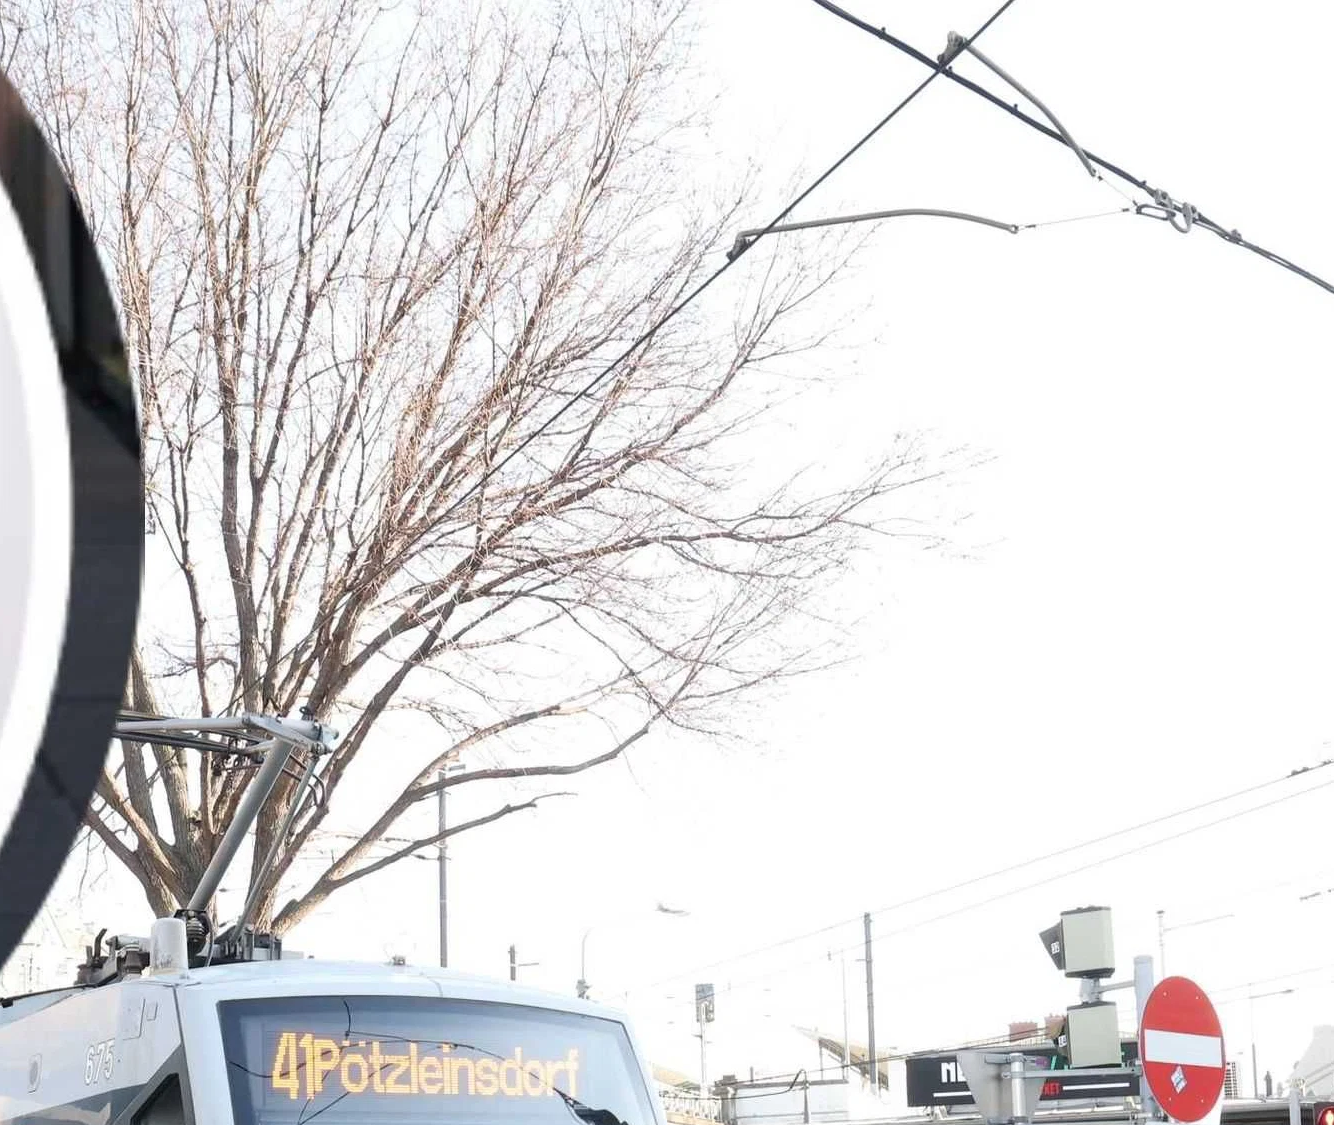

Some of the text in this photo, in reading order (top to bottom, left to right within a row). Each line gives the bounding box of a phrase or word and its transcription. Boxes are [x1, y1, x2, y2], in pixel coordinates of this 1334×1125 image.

[84, 1042, 114, 1084] 675
[271, 1031, 580, 1100] 41 Pötzleinsdorf
